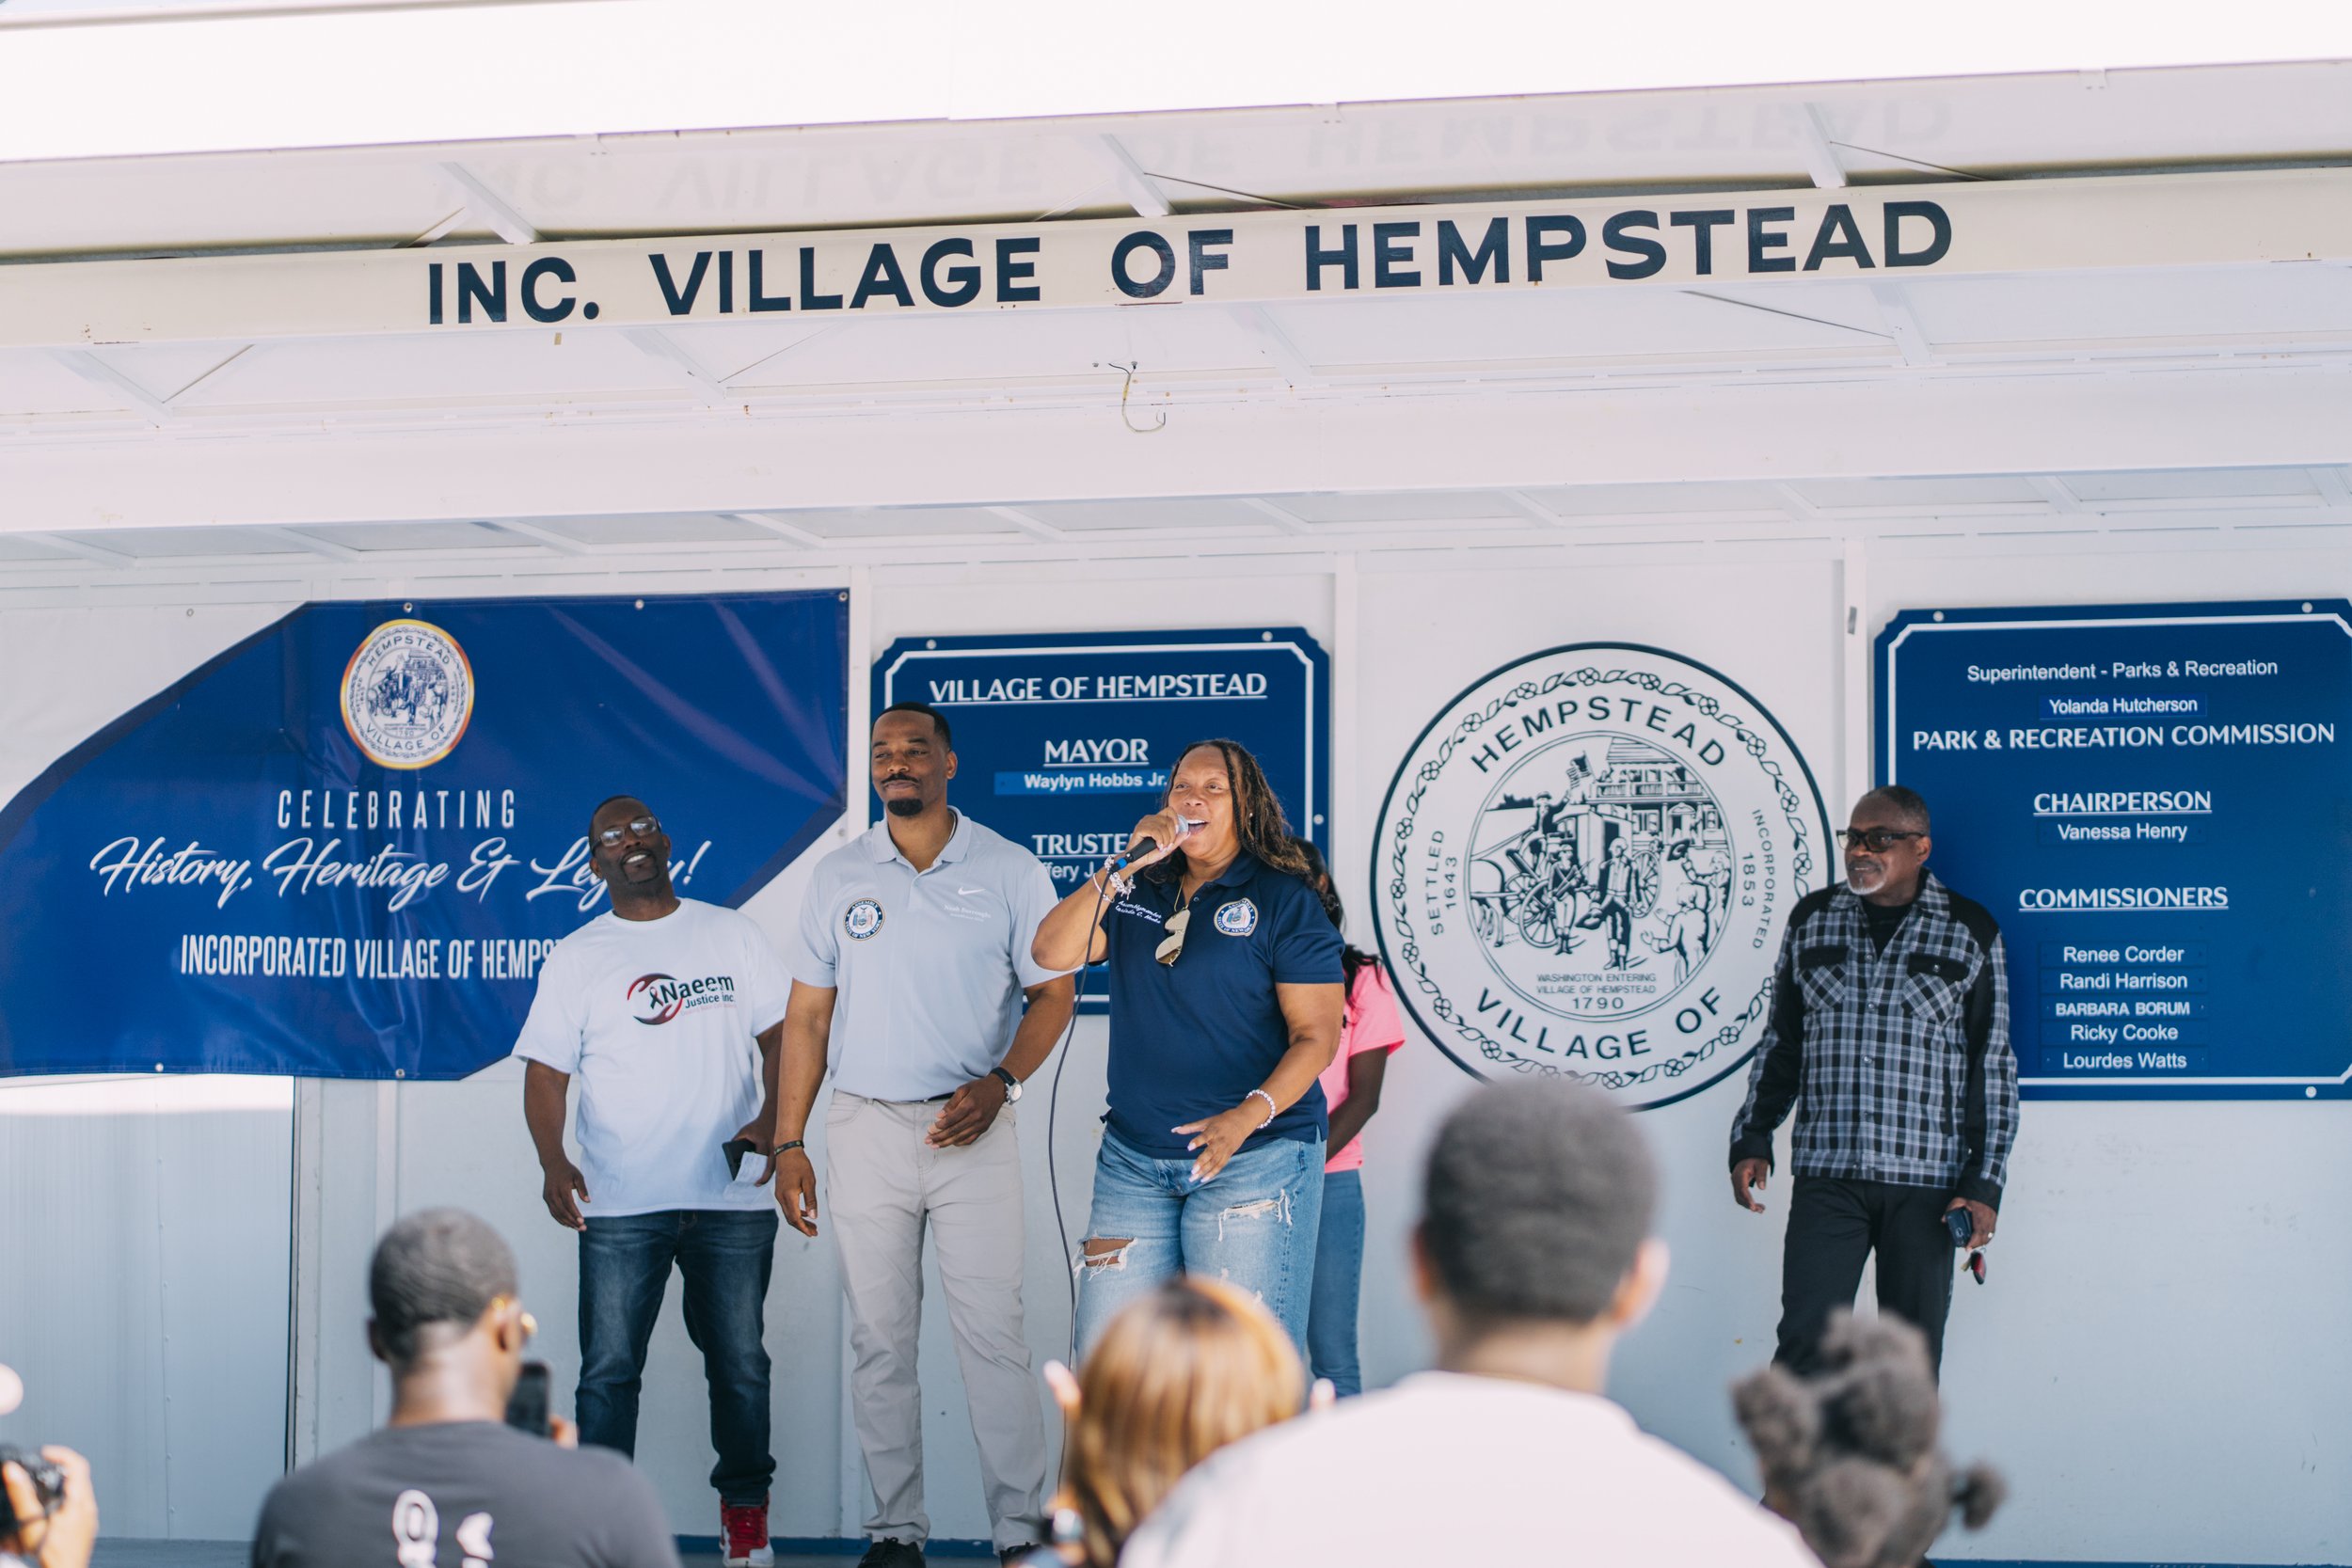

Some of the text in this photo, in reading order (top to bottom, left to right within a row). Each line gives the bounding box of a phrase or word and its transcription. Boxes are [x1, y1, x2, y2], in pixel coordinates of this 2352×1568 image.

[429, 200, 1951, 325] INC. VILLAGE OF HEMPSTEAD
[368, 635, 450, 666] HEMPSTEAD
[1968, 664, 2096, 684] Superintendent
[2113, 662, 2162, 678] Parks
[2167, 661, 2180, 677] &
[2185, 659, 2278, 676] Recreation
[930, 673, 1267, 702] VILLAGE OF HEMPSTEAD
[2049, 698, 2198, 715] Yolanda Hutcherson
[367, 723, 446, 751] VILLAGE OF
[1470, 696, 1725, 773] HEMPSTEAD
[1914, 723, 2335, 751] PARK & RECREATION COMMISSION
[1044, 738, 1149, 763] MAYOR
[1024, 772, 1168, 793] Waylyn Hobbs Jr.
[278, 789, 515, 830] CELEBRATING
[2034, 791, 2212, 812] CHAIRPERSON
[1031, 832, 1133, 854] TRUSTE
[2058, 823, 2187, 843] Vanessa Henry
[90, 837, 252, 909] History,
[262, 837, 450, 912] Heritage
[1426, 830, 1444, 936] SETTLED
[1446, 857, 1457, 910] 1643
[1742, 852, 1754, 908] 1853
[1753, 809, 1775, 949] INCORPORATED
[2020, 887, 2229, 908] COMMISSIONERS
[182, 935, 346, 978] INCORPORATED
[355, 939, 440, 979] VILLAGE
[448, 940, 474, 979] OF
[2064, 945, 2185, 962] Renee Corder
[660, 976, 734, 1004] Naeem
[1536, 974, 1656, 982] WASHINGTON ENTERING
[1536, 985, 1656, 993] VILLAGE OF HEMPSTEAD
[2060, 973, 2187, 989] Randi Harrison
[685, 993, 720, 1008] Justice
[1573, 997, 1624, 1009] 1790
[2056, 1002, 2190, 1016] BARBARA BORUM
[1476, 987, 1722, 1059] VILLAGE OF
[2072, 1024, 2178, 1044] Ricky Cooke
[2064, 1053, 2186, 1069] Lourdes Watts
